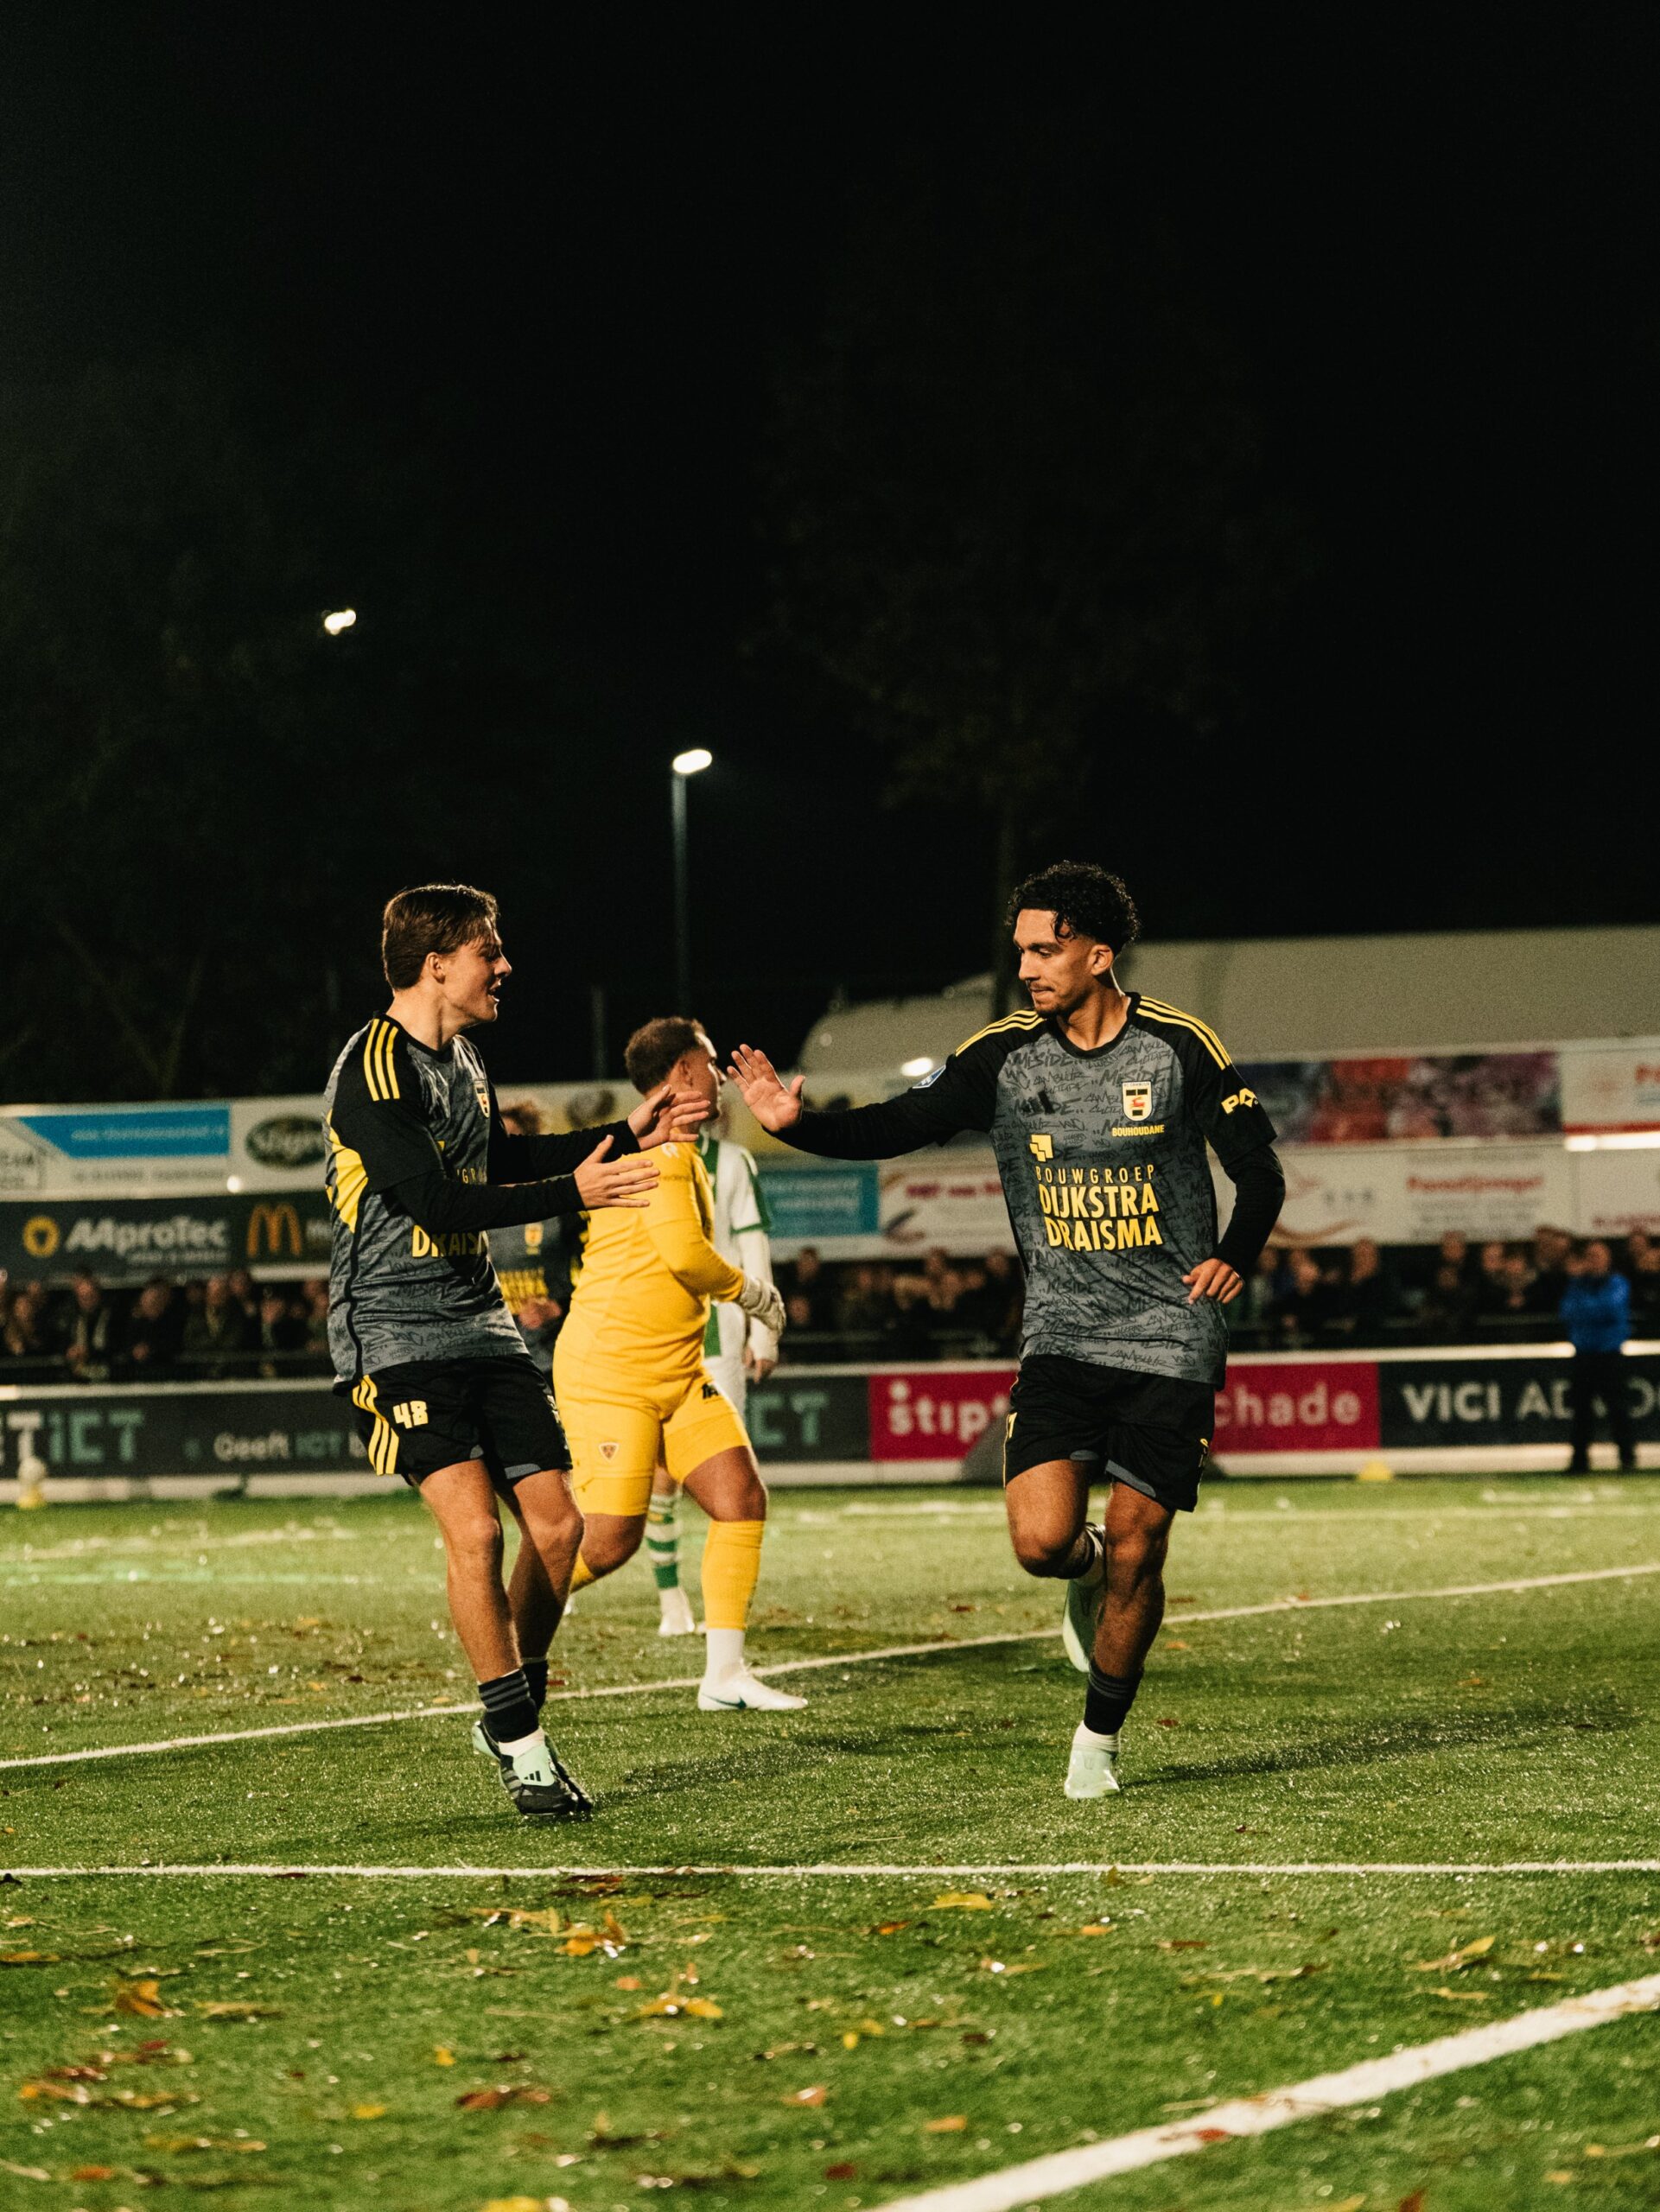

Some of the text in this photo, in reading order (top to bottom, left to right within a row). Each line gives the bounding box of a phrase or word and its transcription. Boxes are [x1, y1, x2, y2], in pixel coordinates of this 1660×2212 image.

[1112, 1124, 1165, 1136] BOUHOUDANE
[1035, 1164, 1154, 1184] BOUWGROEP
[1039, 1182, 1160, 1219] DIJKSTRA
[1044, 1215, 1163, 1252] DRAISMA
[392, 1400, 429, 1429] 48
[1213, 1382, 1363, 1427] chade
[1401, 1382, 1502, 1421] VICI
